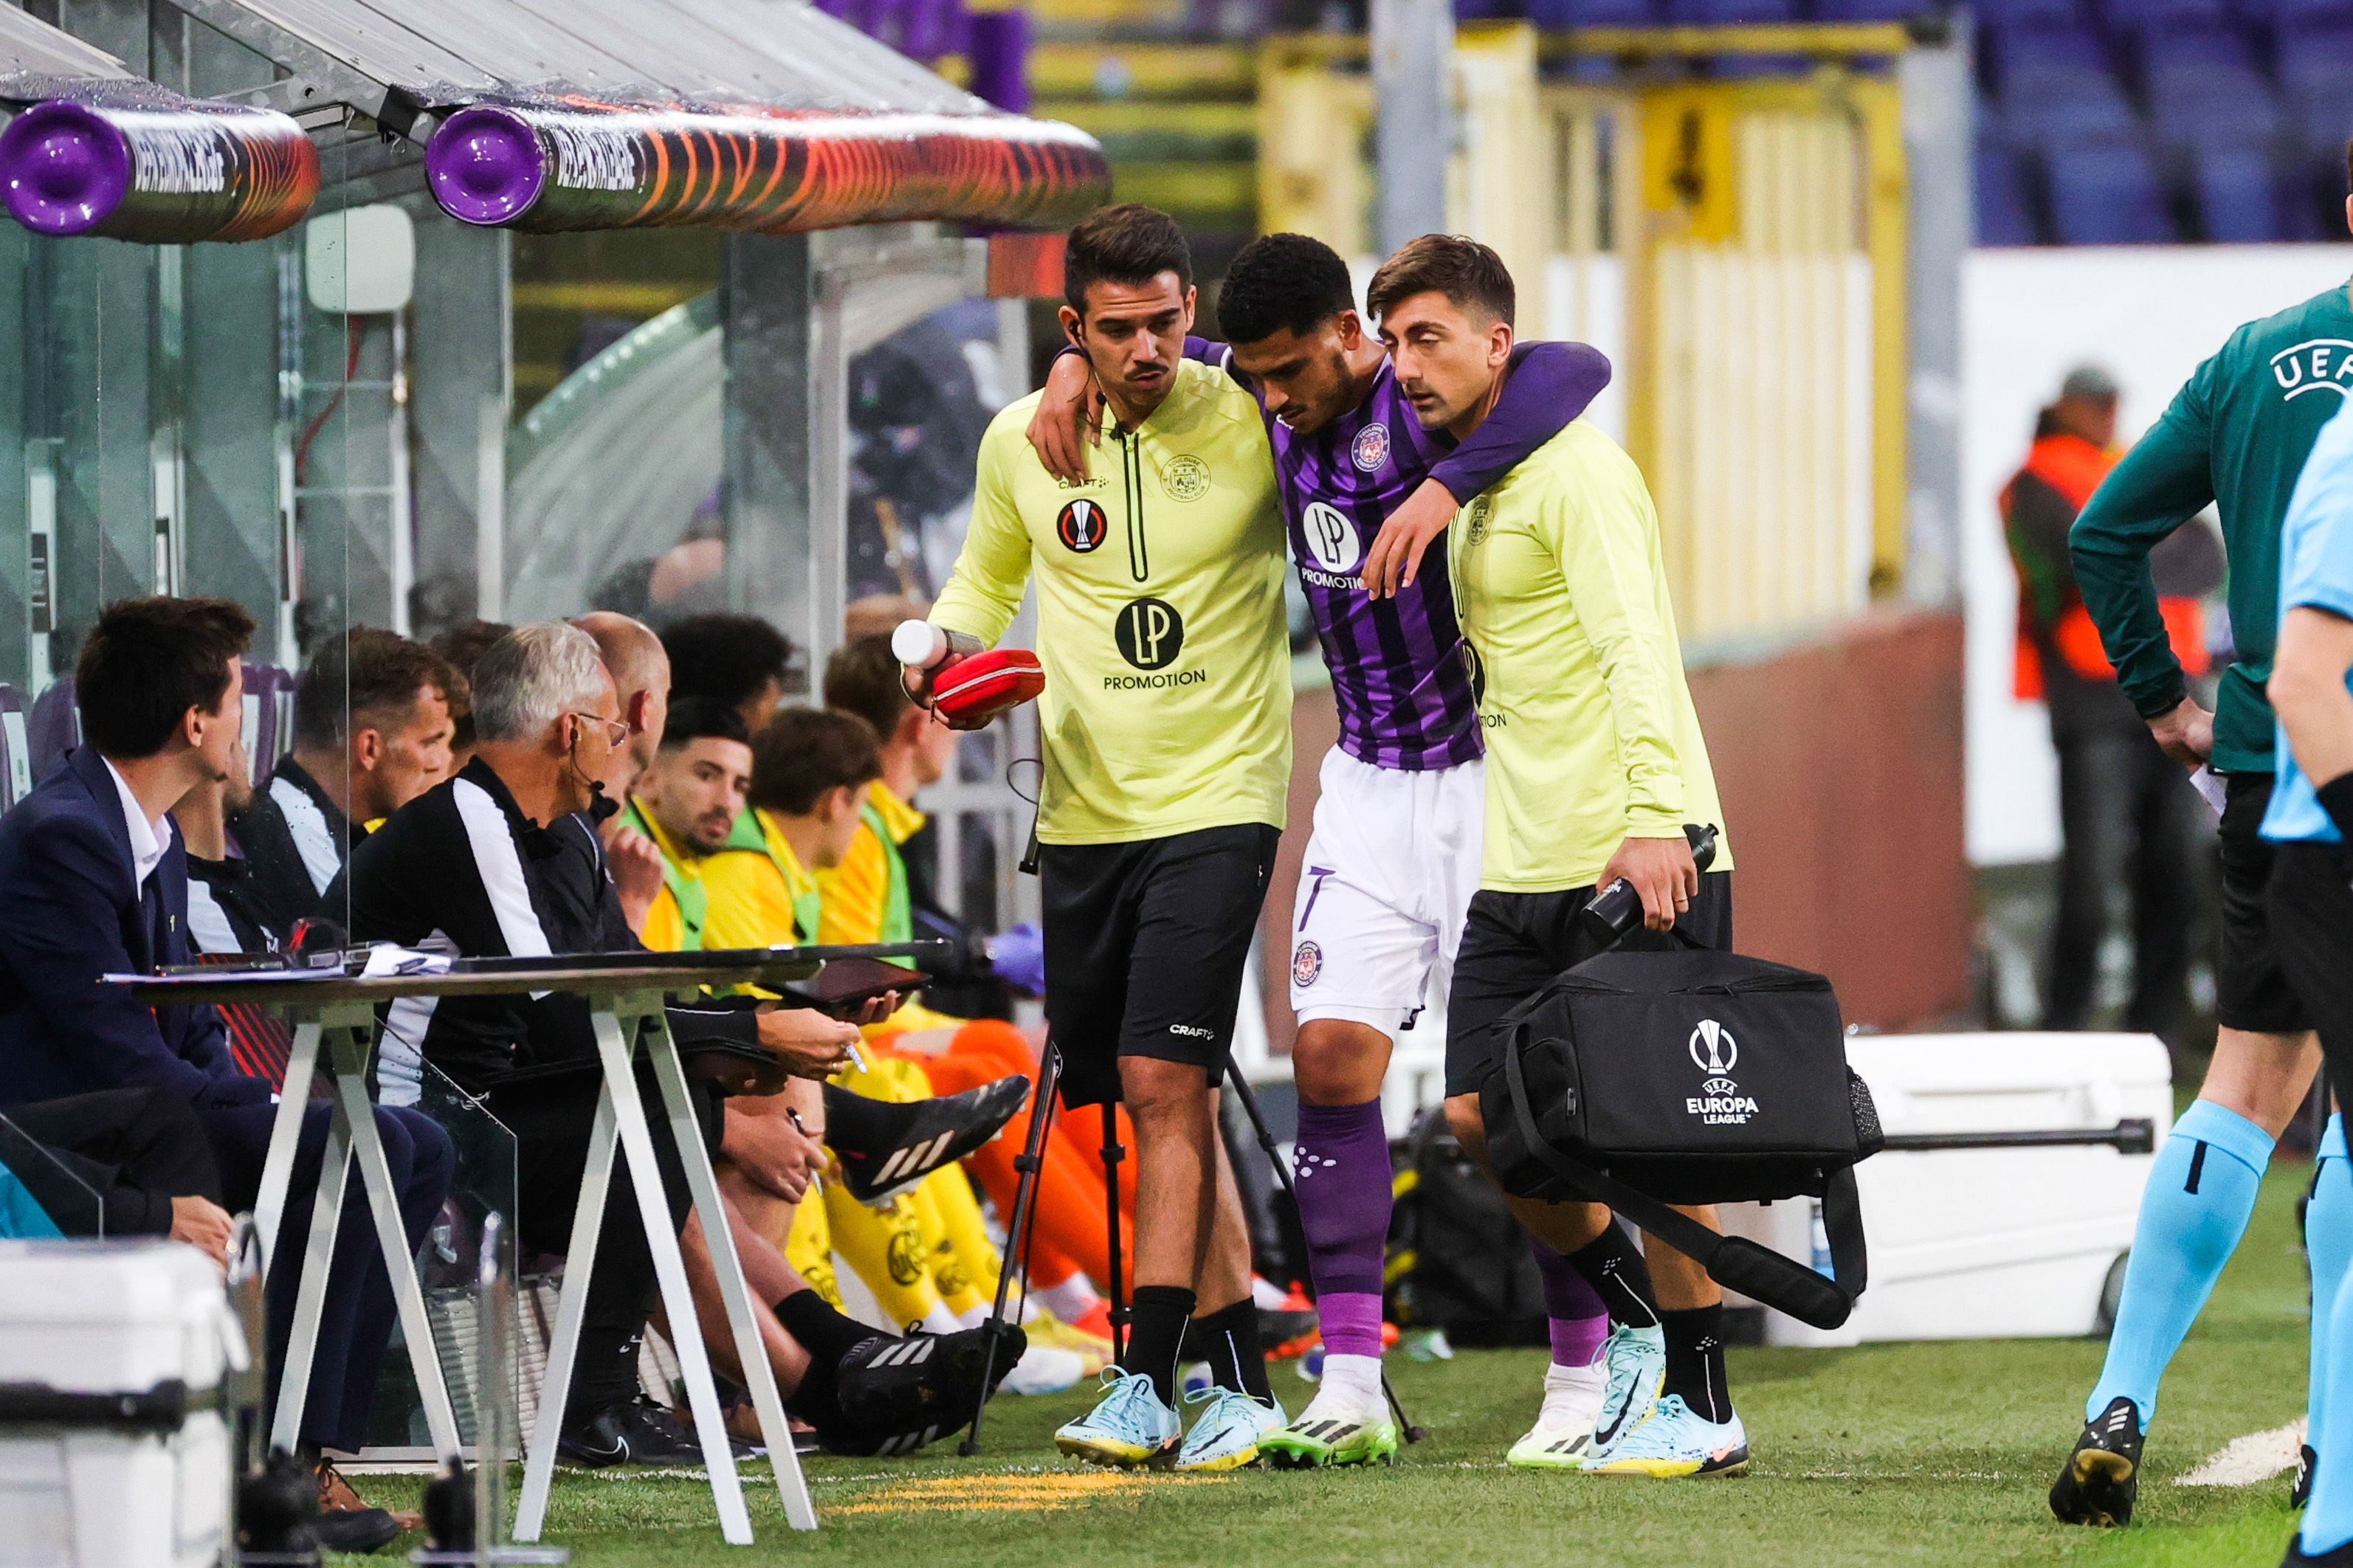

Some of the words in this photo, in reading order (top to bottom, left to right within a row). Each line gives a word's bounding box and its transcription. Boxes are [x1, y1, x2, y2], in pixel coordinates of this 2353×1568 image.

[2274, 348, 2353, 388] UEF
[1168, 457, 1201, 468] TOULOUSE
[1058, 478, 1098, 489] CAFT
[1314, 508, 1345, 564] LP
[1301, 567, 1365, 590] PROMOTI
[1131, 604, 1171, 664] LP
[1104, 669, 1206, 690] PROMOTION
[1298, 866, 1337, 933] 7
[1169, 1024, 1208, 1037] CRAFT
[1704, 1080, 1734, 1094] UEFA
[1686, 1097, 1760, 1113] EUROPA
[1703, 1114, 1746, 1125] LEAGUE
